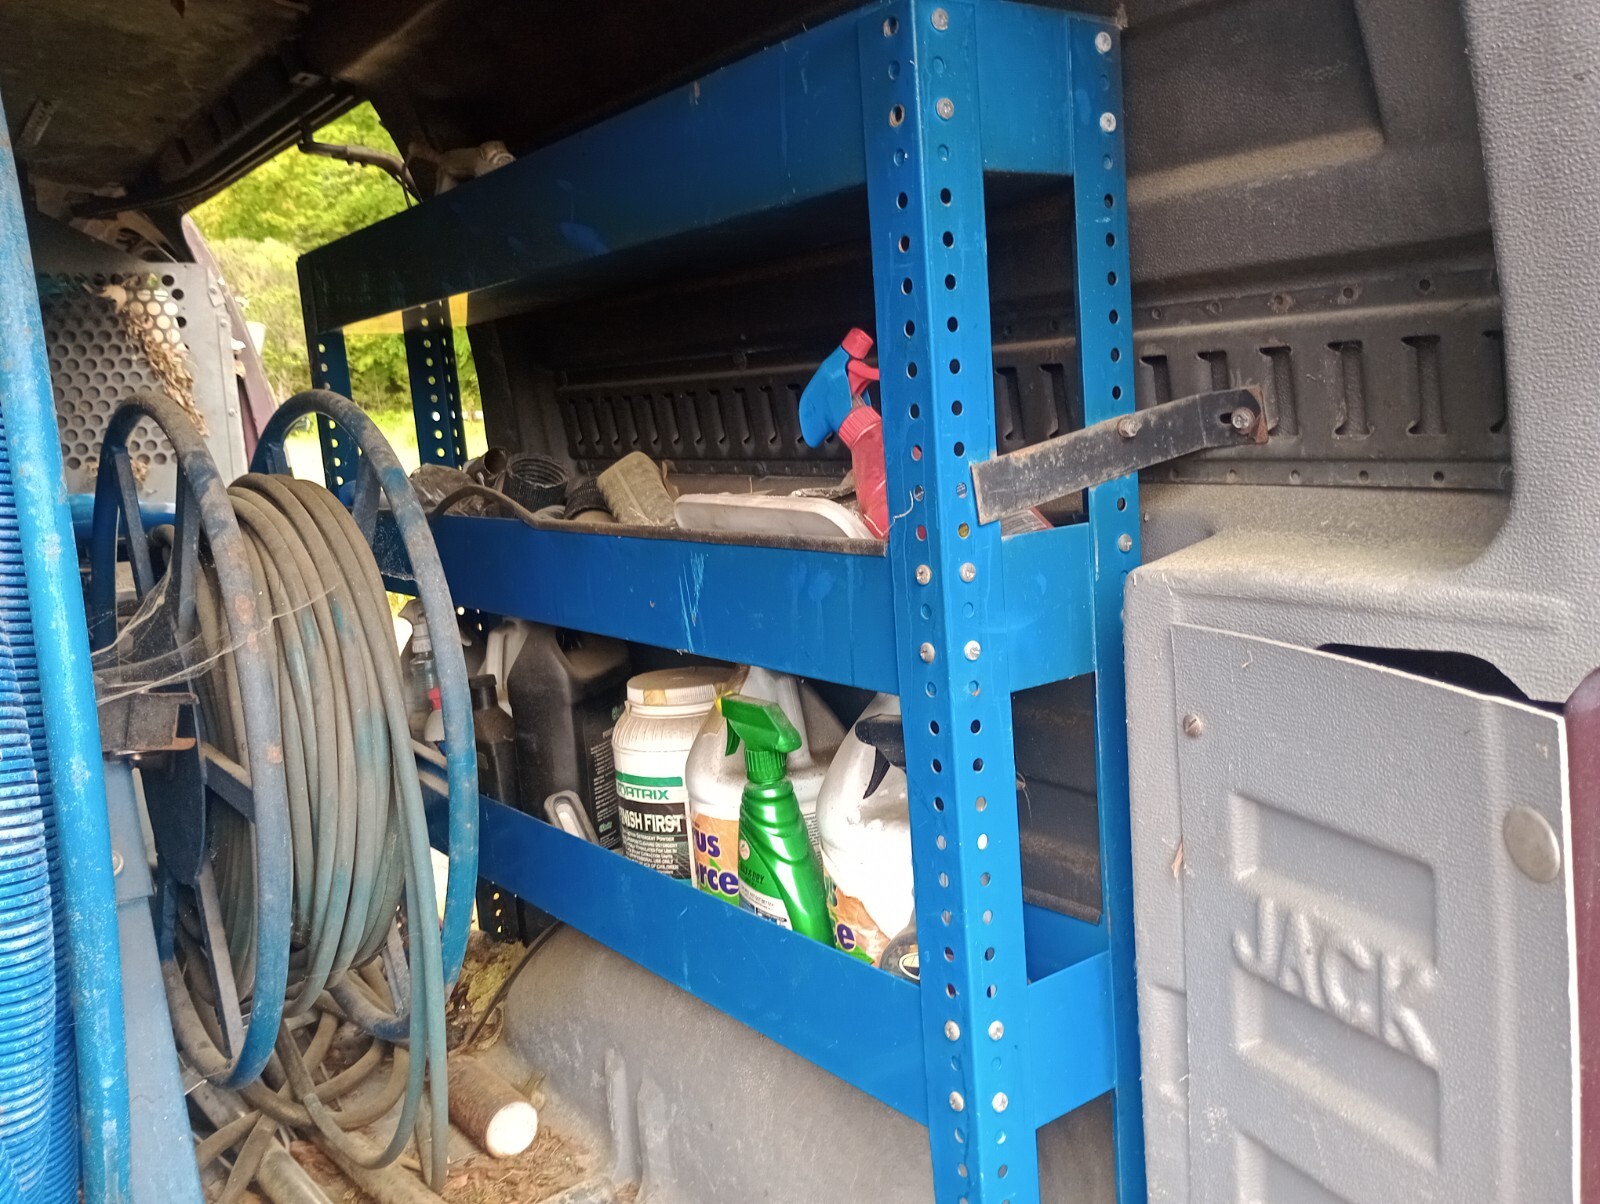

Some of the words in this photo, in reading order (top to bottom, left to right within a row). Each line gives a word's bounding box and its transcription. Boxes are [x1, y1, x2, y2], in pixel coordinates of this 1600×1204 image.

[644, 813, 682, 833] FIRST
[696, 862, 738, 895] rce
[1232, 896, 1439, 1066] JACK
